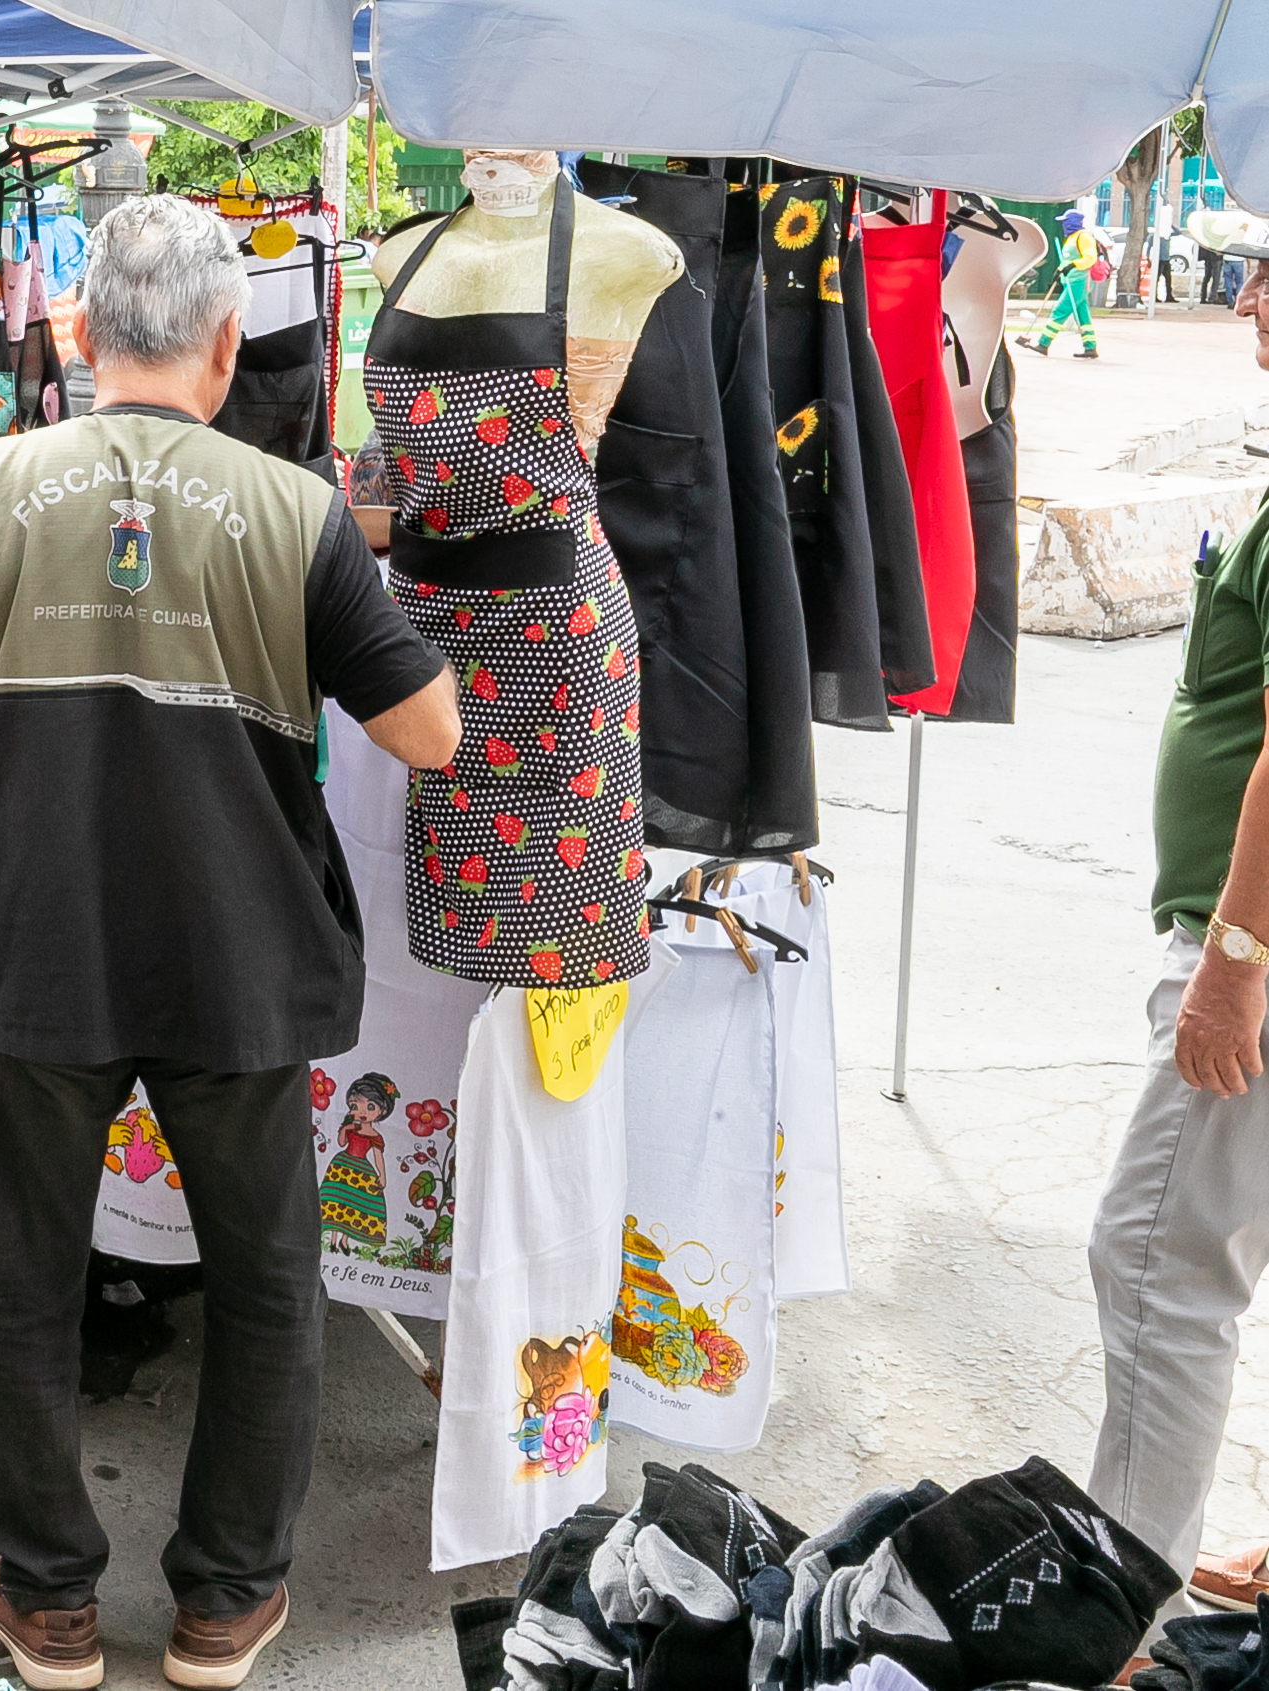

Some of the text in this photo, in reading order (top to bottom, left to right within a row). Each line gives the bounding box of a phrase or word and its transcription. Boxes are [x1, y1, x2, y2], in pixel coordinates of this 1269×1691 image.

[12, 456, 247, 540] FISCALIZAÇÃO
[33, 604, 135, 621] PREFEITURA
[552, 1051, 564, 1080] 3
[138, 1217, 165, 1231] Senhor
[331, 1265, 340, 1277] e
[339, 1265, 359, 1281] fé
[361, 1272, 385, 1287] em
[389, 1275, 433, 1294] Deus.
[659, 1394, 692, 1411] Senhor
